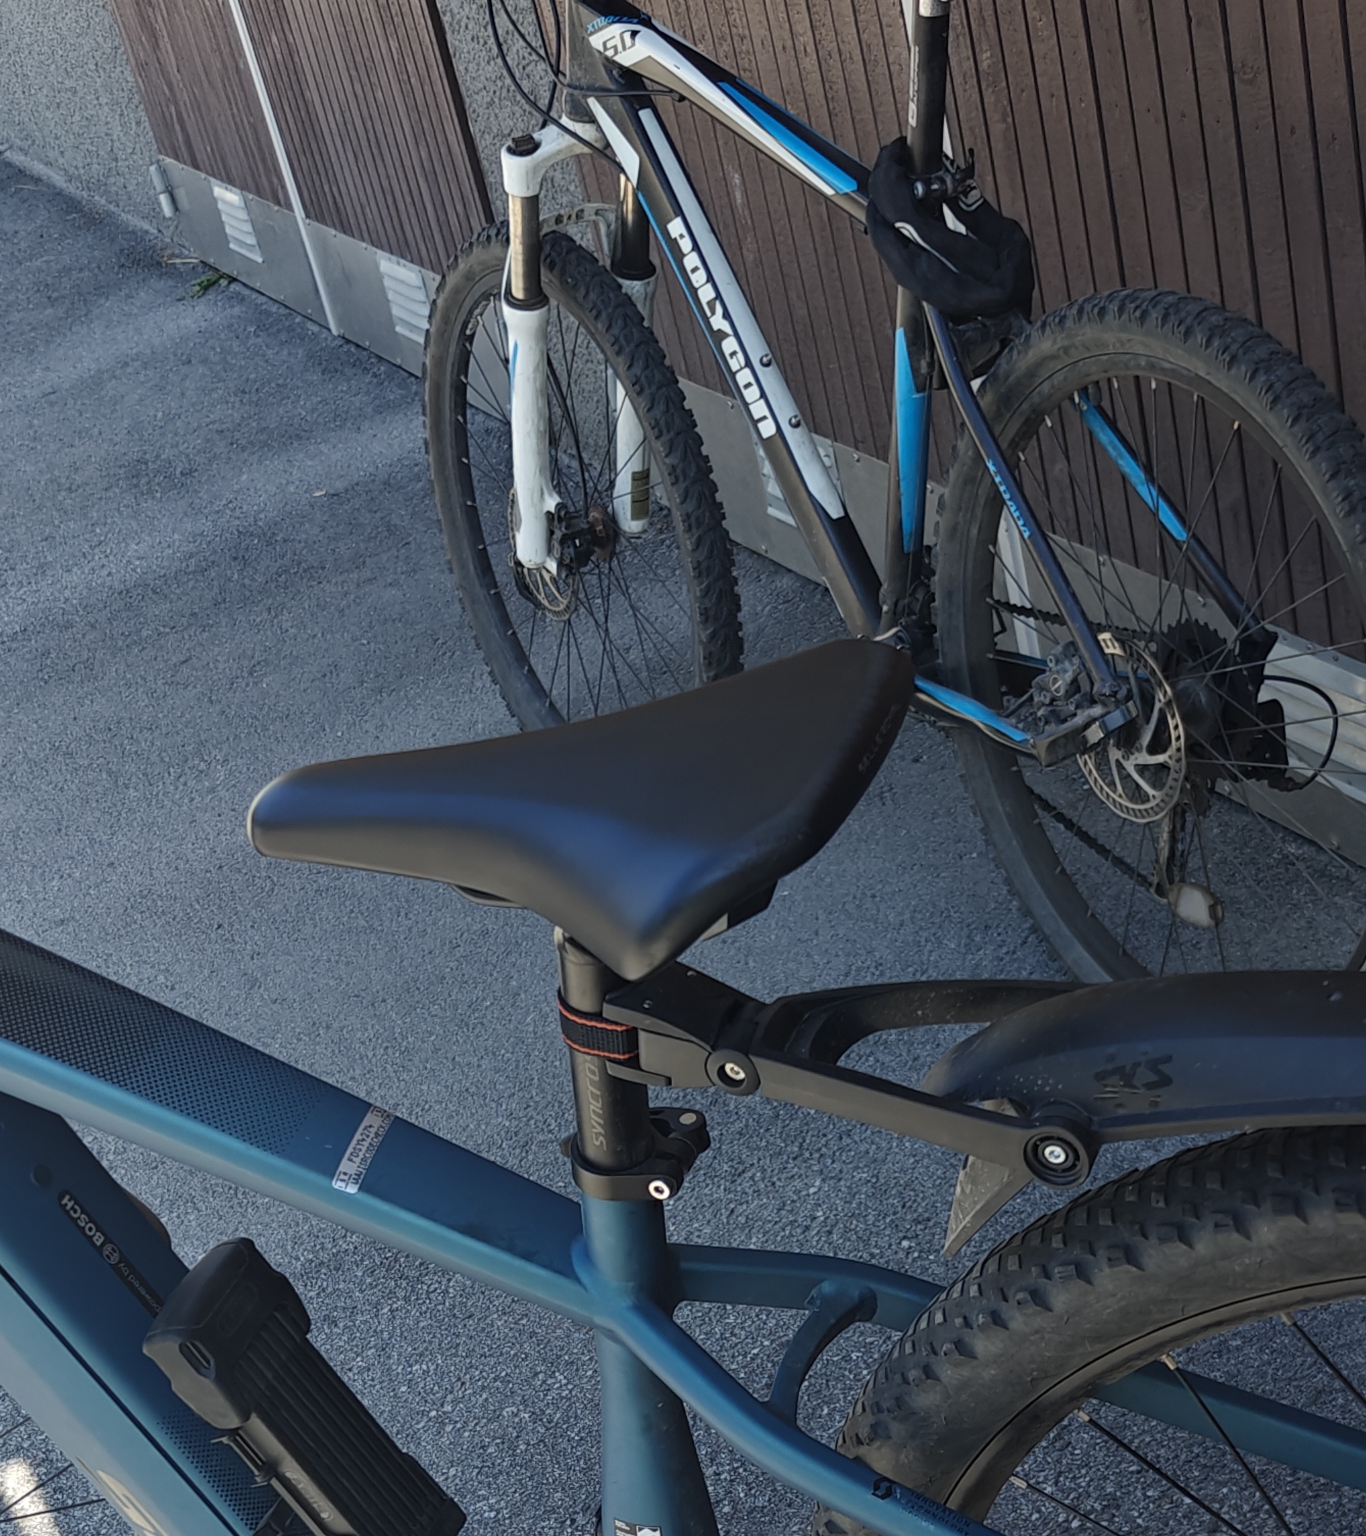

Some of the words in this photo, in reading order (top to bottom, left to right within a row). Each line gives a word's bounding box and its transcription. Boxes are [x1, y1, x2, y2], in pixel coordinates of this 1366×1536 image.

[666, 216, 777, 439] POLYGON
[59, 1193, 105, 1247] BOSCH
[117, 1261, 130, 1275] by
